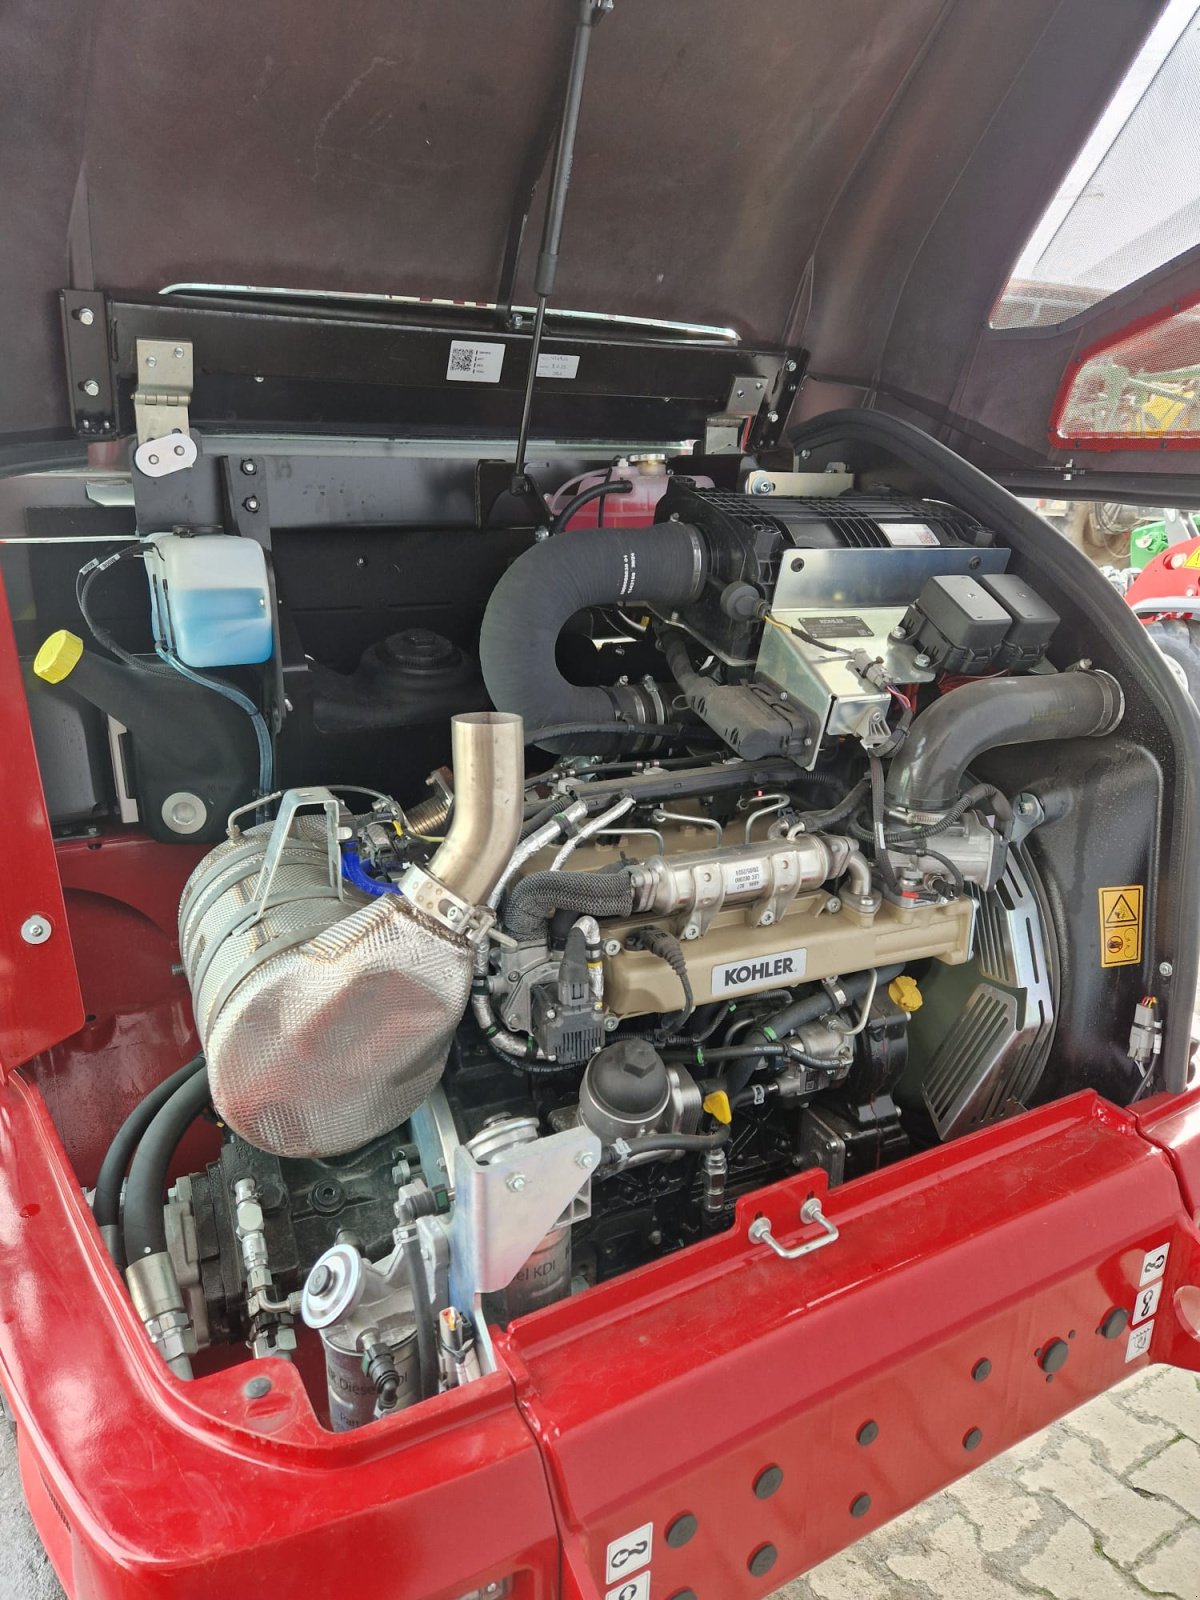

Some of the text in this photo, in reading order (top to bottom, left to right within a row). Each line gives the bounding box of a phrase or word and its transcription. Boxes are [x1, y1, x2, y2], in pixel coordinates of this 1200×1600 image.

[724, 957, 793, 987] KOHLER
[533, 1260, 556, 1279] KDI
[340, 1378, 377, 1396] Diese
